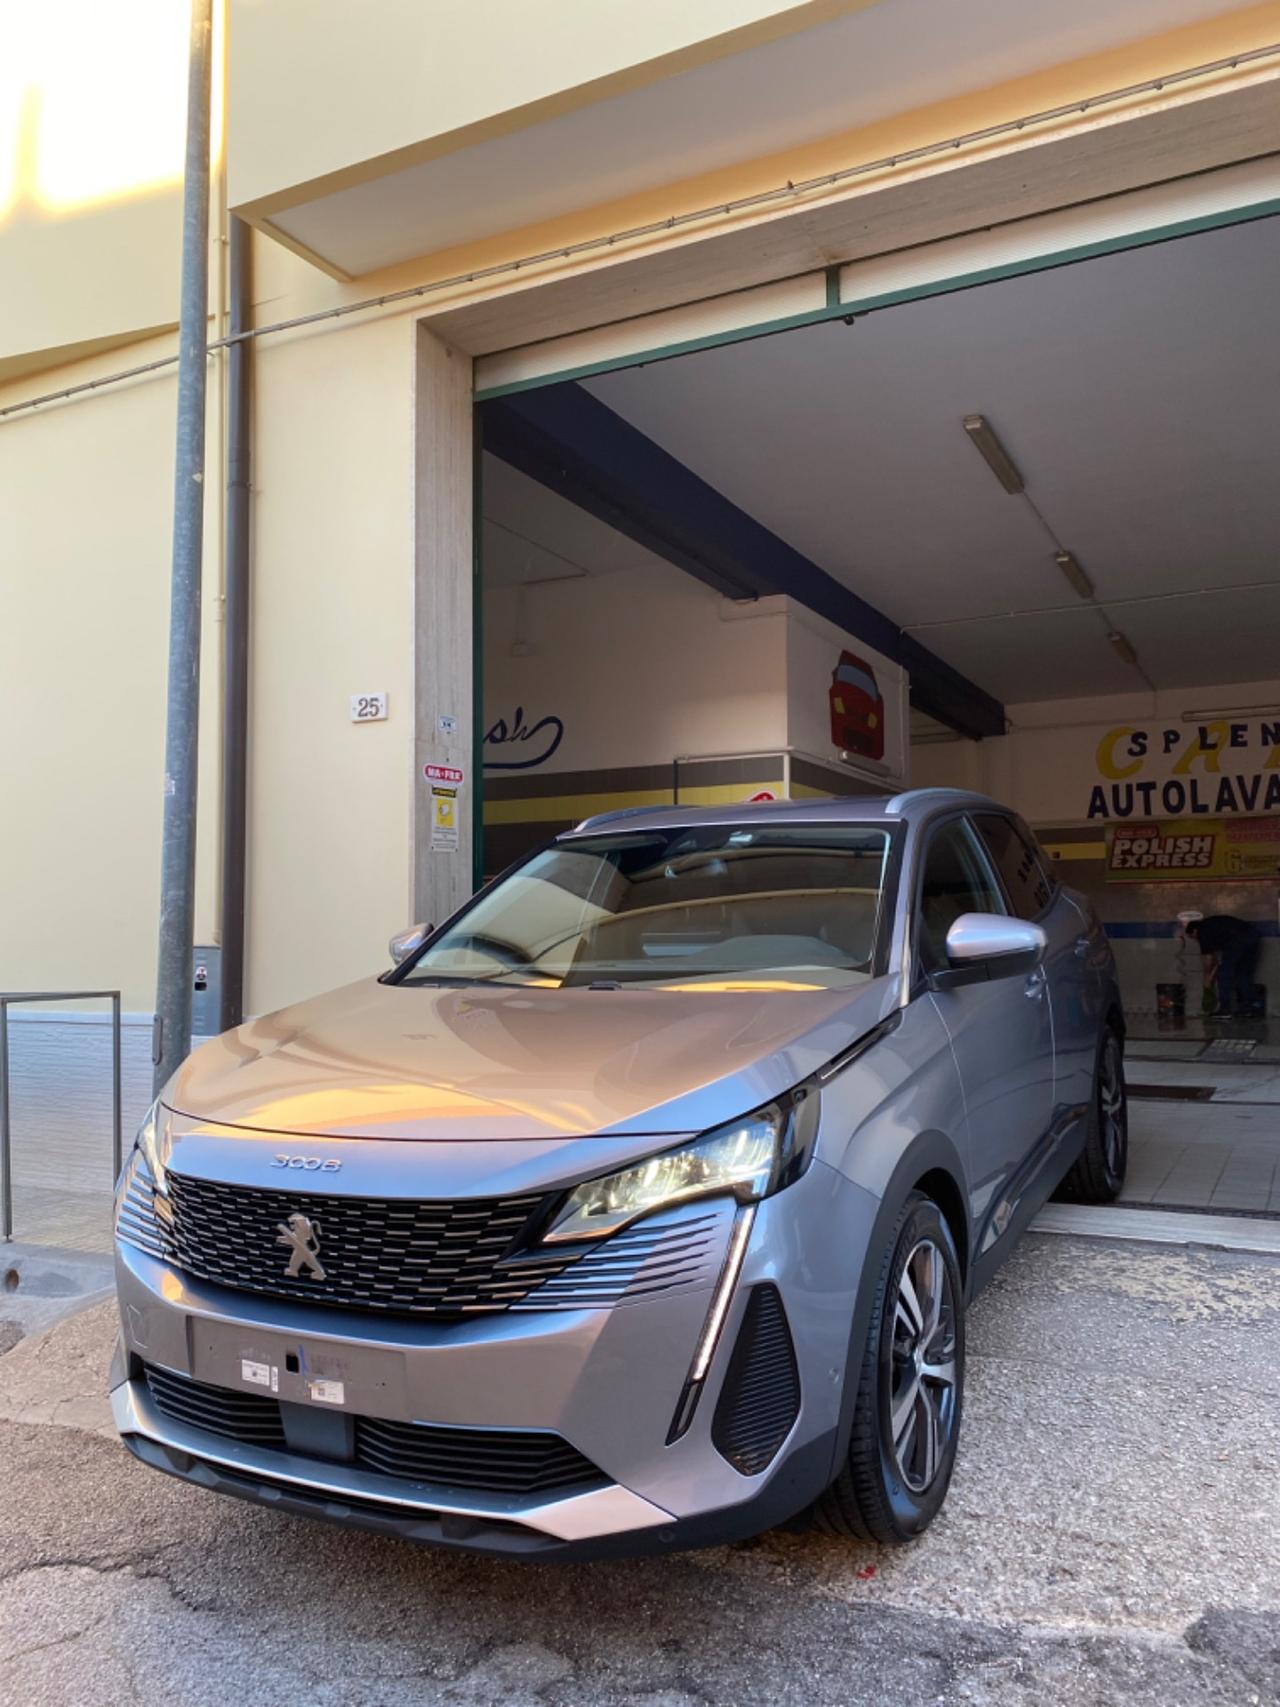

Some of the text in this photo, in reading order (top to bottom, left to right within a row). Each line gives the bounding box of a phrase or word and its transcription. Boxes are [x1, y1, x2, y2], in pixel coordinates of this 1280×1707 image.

[357, 697, 380, 717] 25
[1096, 720, 1280, 779] CA
[1087, 773, 1280, 819] AUTOLAVA
[1113, 836, 1214, 857] POLISH
[1111, 852, 1211, 869] EXPRESS
[270, 1153, 342, 1172] 3008
